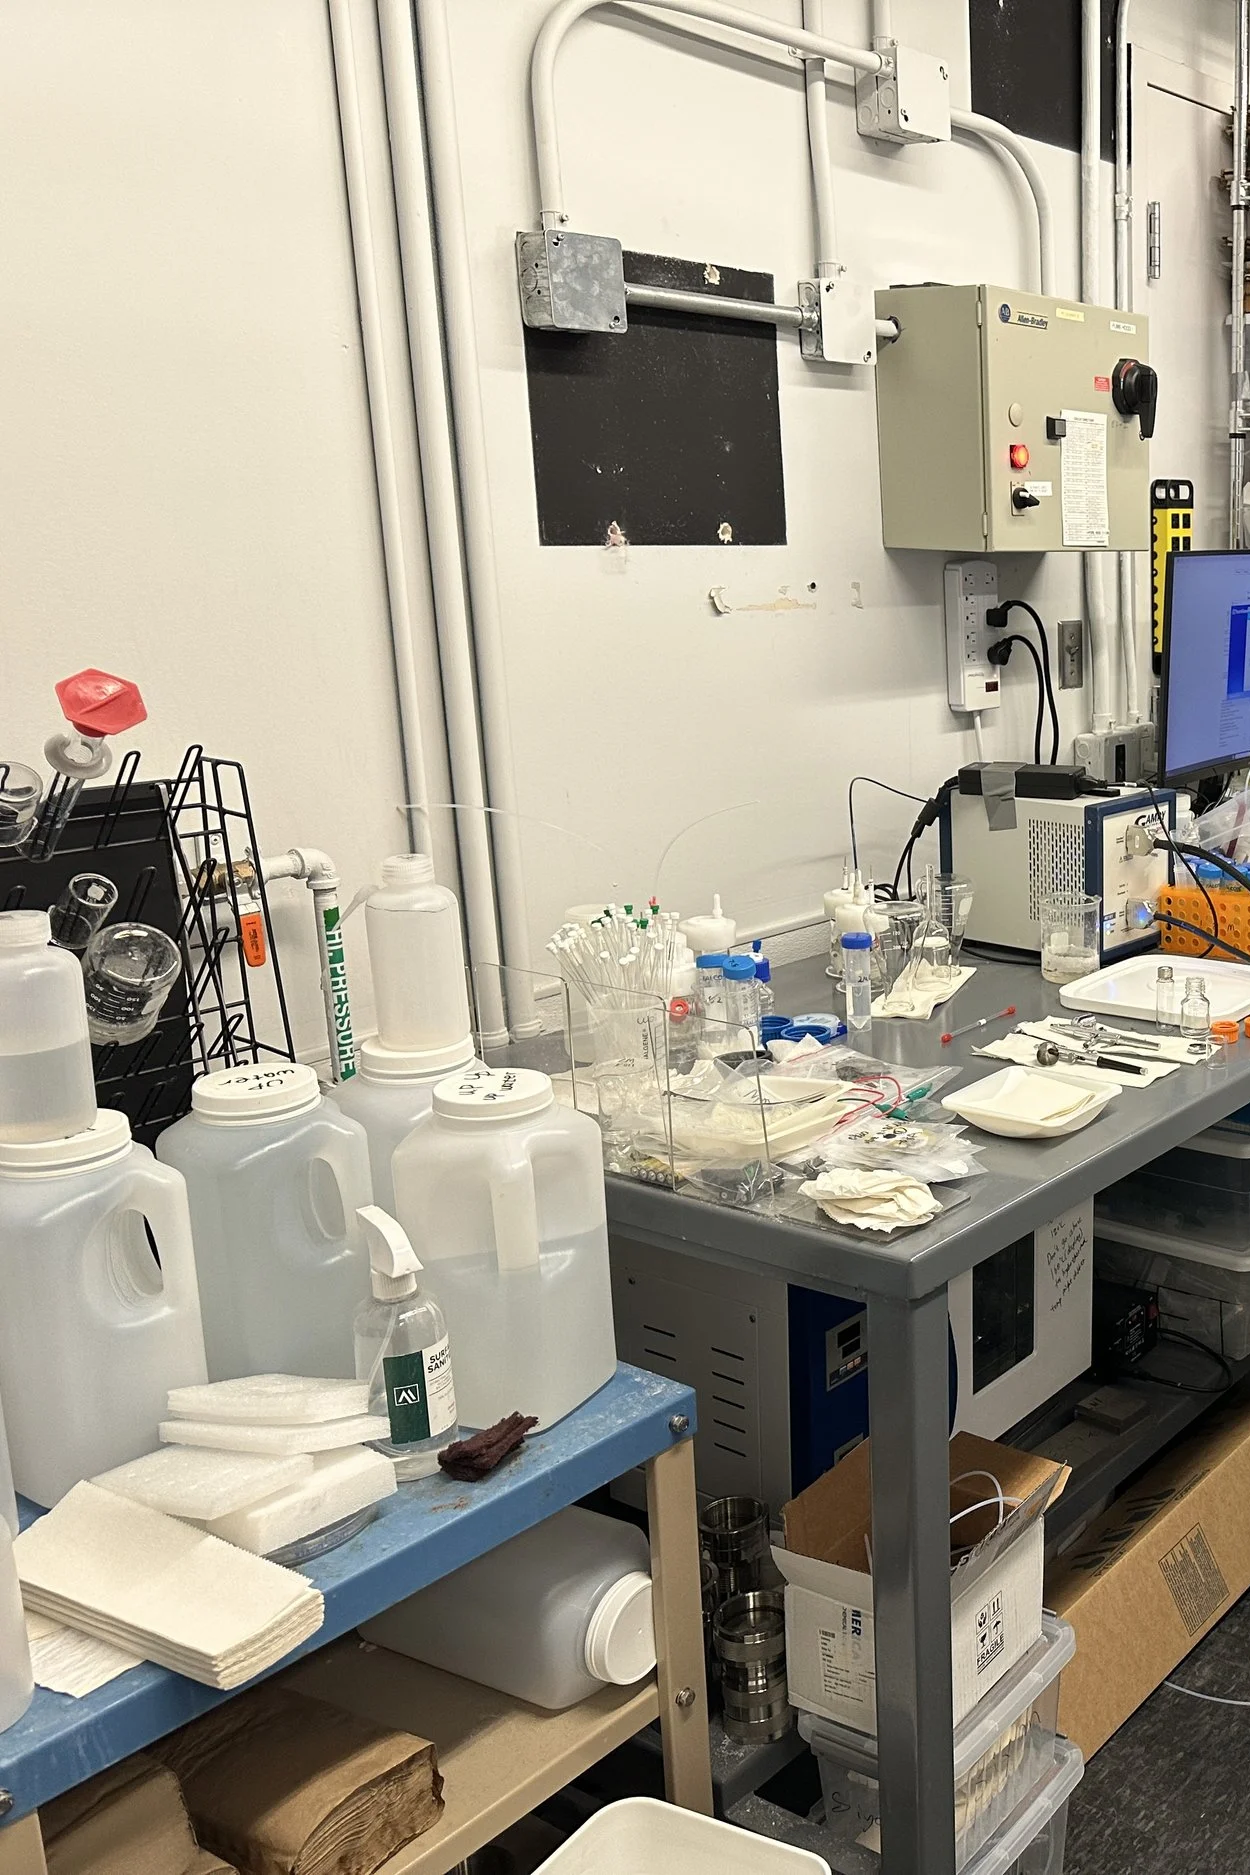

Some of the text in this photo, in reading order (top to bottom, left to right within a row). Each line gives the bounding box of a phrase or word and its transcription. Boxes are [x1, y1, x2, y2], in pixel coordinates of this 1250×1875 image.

[1017, 314, 1048, 328] Allen-Bradley
[329, 963, 357, 1072] PRESSURE
[218, 1069, 295, 1086] water
[976, 1633, 1004, 1666] FRAGILE
